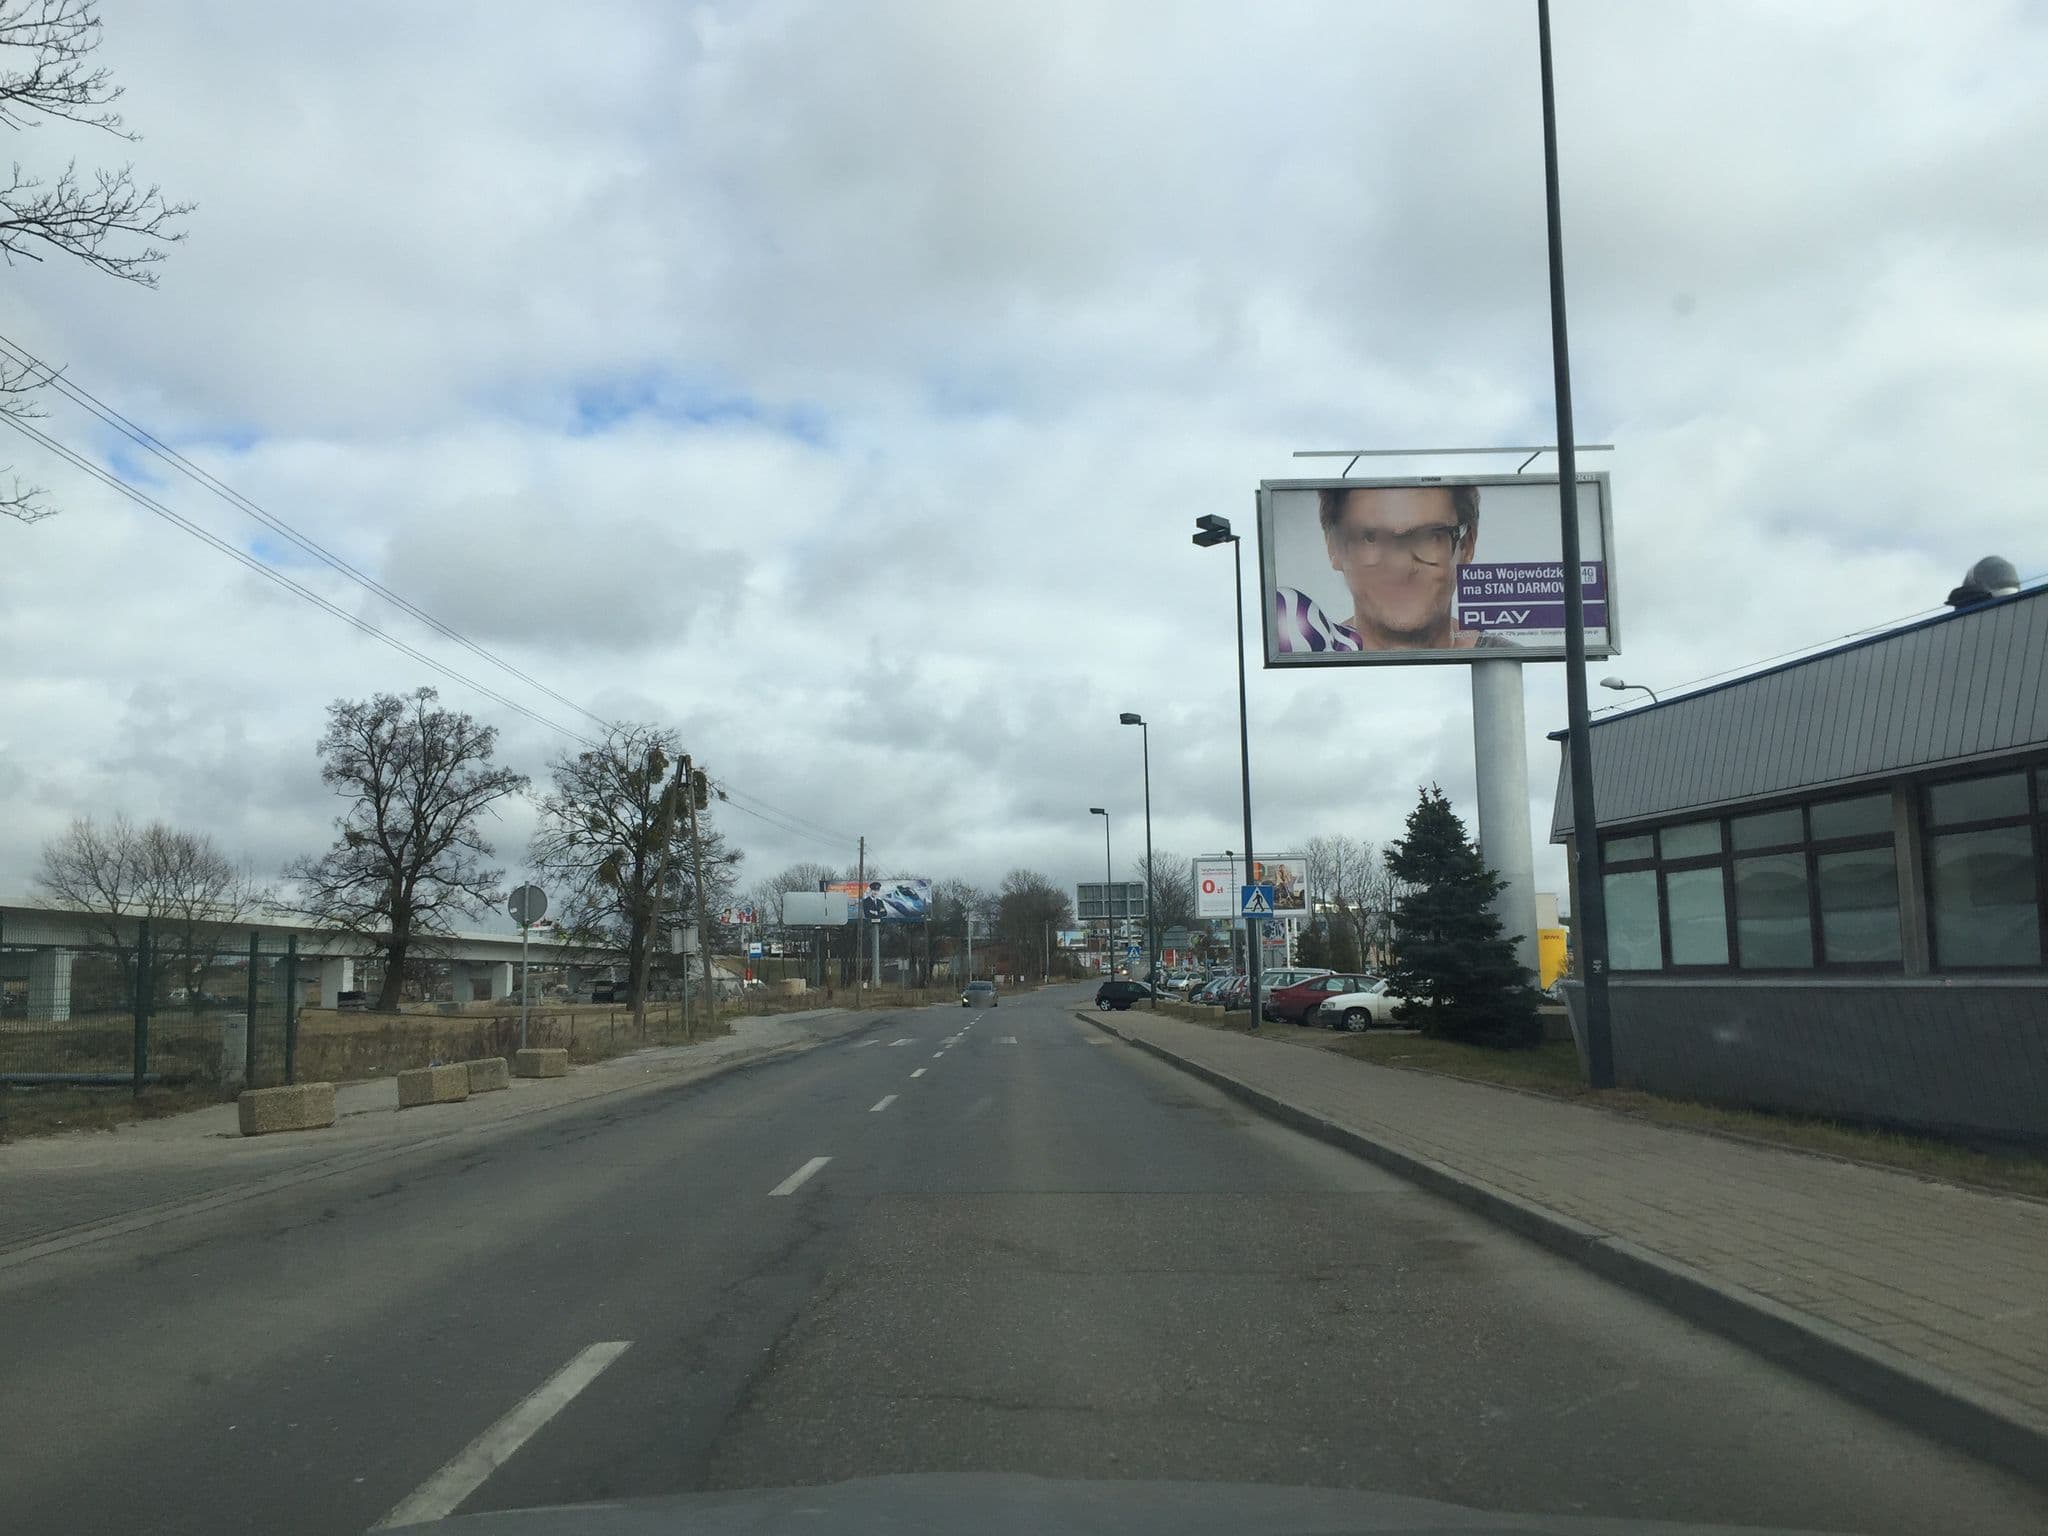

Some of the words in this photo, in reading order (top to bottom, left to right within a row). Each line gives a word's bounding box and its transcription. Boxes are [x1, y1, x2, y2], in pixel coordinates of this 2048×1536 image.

[1462, 568, 1493, 580] Kuba
[1495, 566, 1565, 581] Wojewódzk
[1581, 568, 1594, 577] 4G
[1463, 585, 1482, 595] ma
[1484, 583, 1514, 595] STAN
[1516, 581, 1565, 594] DARMO
[1464, 609, 1531, 625] PLAY
